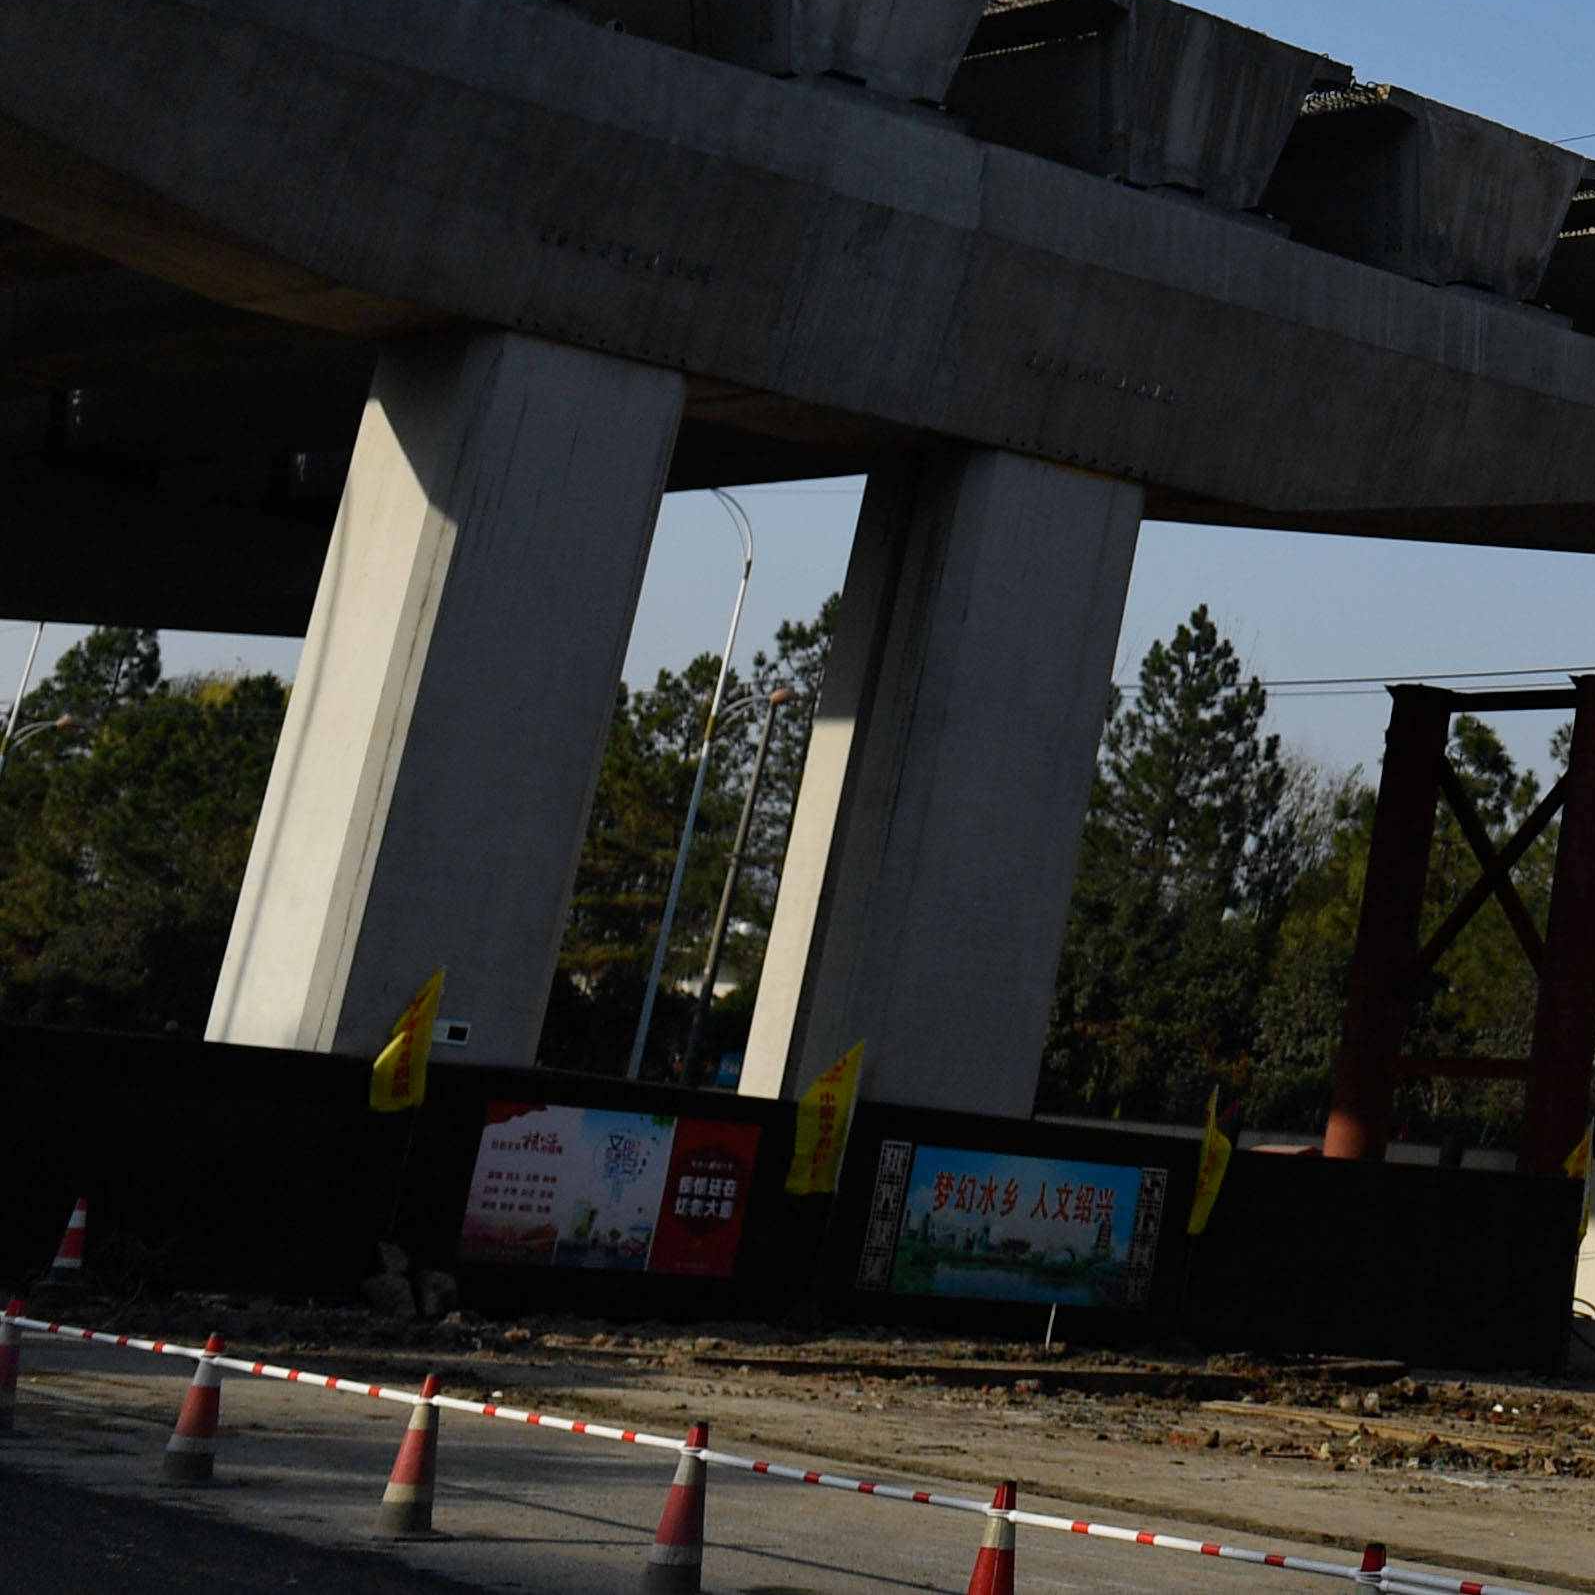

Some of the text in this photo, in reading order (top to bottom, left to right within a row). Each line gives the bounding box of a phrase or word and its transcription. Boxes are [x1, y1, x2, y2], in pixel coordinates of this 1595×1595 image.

[932, 1171, 1116, 1224] 梦幻水乡 人文绍兴
